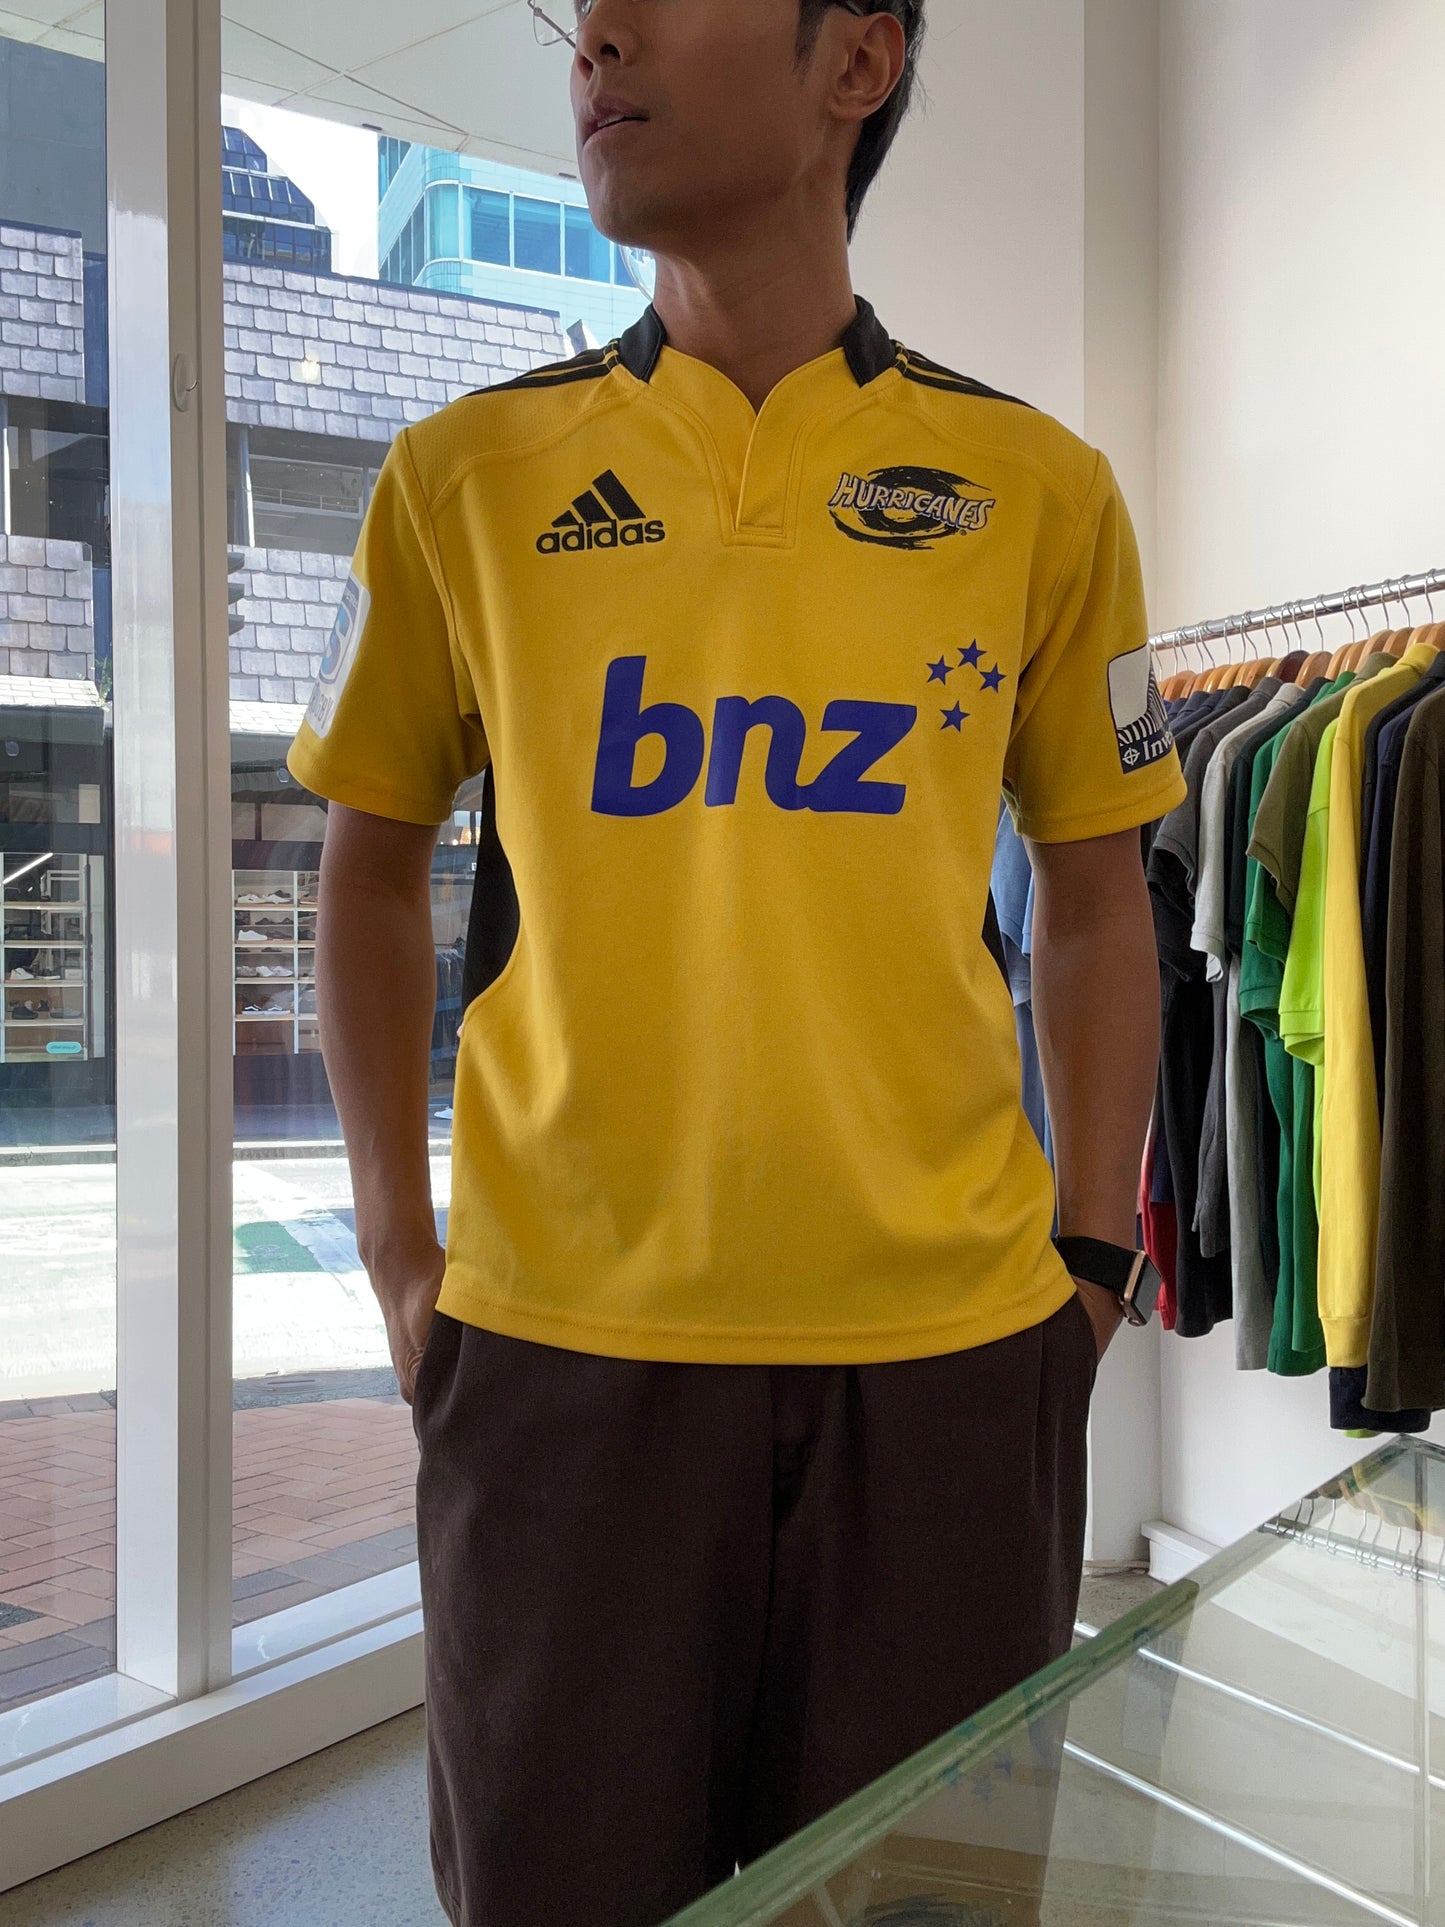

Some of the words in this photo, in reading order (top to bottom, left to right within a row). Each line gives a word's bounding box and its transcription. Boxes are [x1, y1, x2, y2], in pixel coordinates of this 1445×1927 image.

[827, 472, 996, 530] HURRICANES
[536, 519, 666, 554] adidas
[591, 655, 918, 817] bnz
